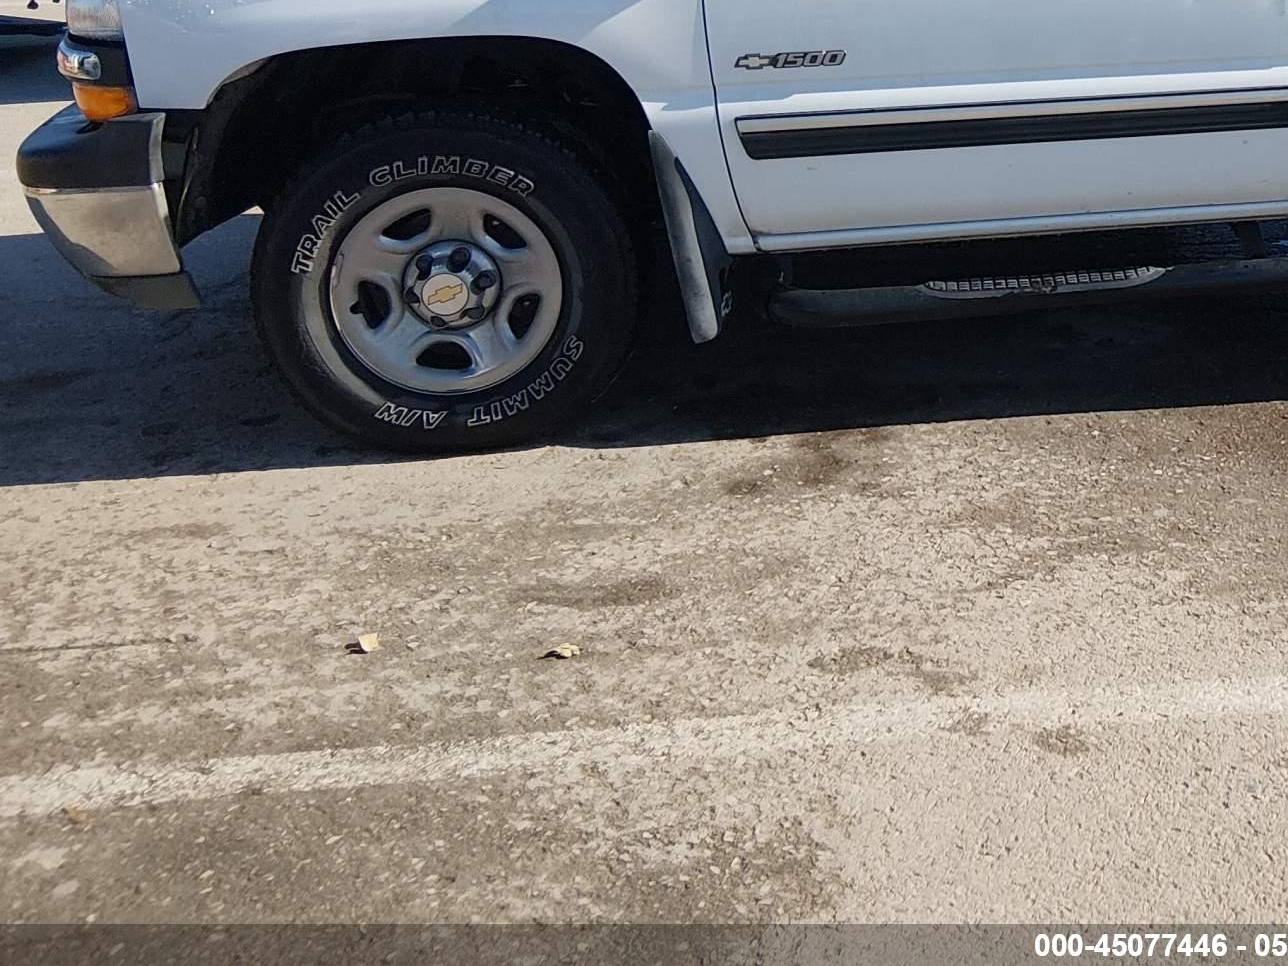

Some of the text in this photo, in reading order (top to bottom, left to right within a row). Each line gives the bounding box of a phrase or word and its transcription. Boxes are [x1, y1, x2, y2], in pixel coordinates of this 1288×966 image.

[773, 50, 847, 68] 1500
[291, 155, 535, 274] TRAIL CLIMBER
[467, 334, 584, 427] SUMMIT
